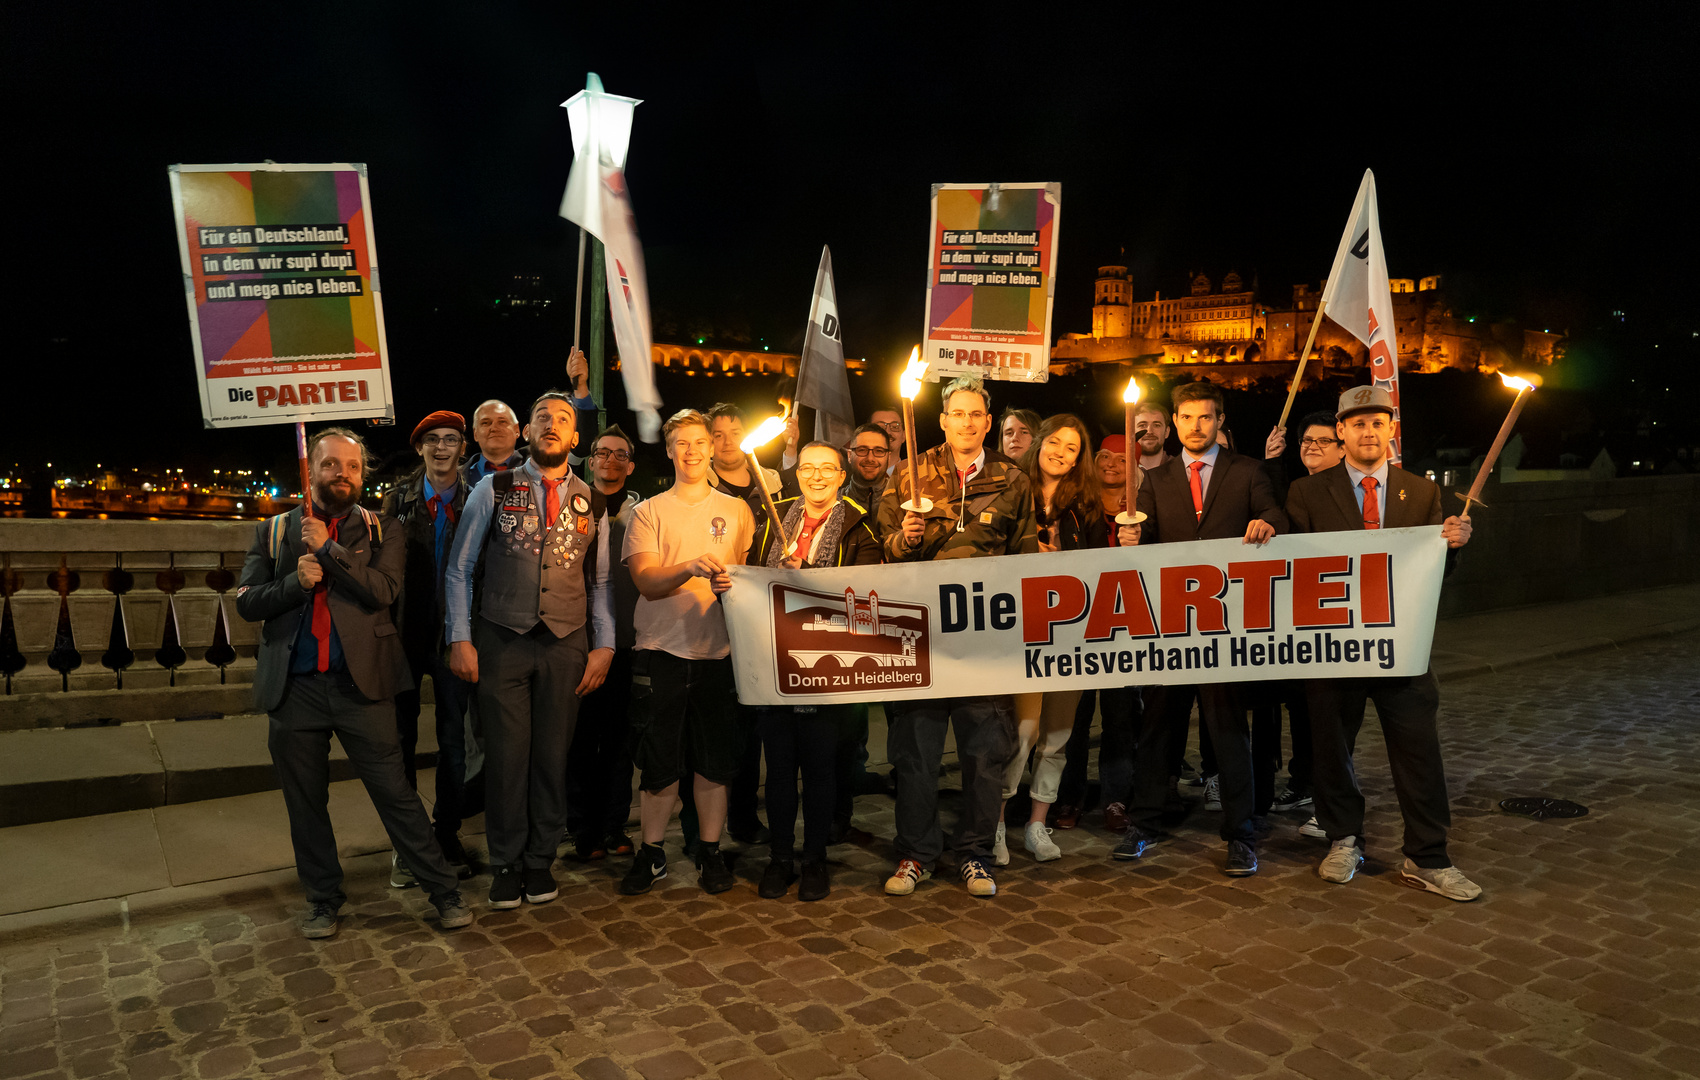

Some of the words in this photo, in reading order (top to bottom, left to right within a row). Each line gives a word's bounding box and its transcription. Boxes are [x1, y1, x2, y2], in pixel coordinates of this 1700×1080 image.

[200, 228, 225, 245] Für
[228, 228, 252, 244] ein
[254, 226, 349, 243] Deutschland,
[943, 231, 959, 244] Für
[959, 231, 974, 244] ein
[975, 231, 1038, 246] Deutschland,
[203, 256, 219, 272] in
[222, 255, 254, 271] dem
[257, 254, 283, 270] wir
[286, 252, 318, 271] supi
[320, 251, 353, 270] dupi
[941, 251, 951, 263] in
[952, 251, 972, 263] dem
[973, 251, 990, 263] wir
[991, 252, 1013, 266] supi
[1015, 252, 1038, 267] dupi
[940, 270, 957, 283] und
[958, 273, 984, 285] mega
[986, 271, 1007, 283] nice
[1009, 272, 1040, 285] leben.
[207, 282, 236, 298] und
[239, 283, 280, 299] mega
[282, 279, 314, 295] nice
[316, 278, 361, 294] leben.
[939, 347, 954, 359] Die
[955, 348, 1032, 370] PARTEI
[228, 387, 254, 403] Die
[256, 379, 370, 408] PARTEI
[504, 498, 528, 508] CSU
[938, 581, 1017, 634] Die
[1021, 552, 1395, 647] PARTEI
[1024, 637, 1219, 678] Kreisverband
[1230, 632, 1395, 669] Heidelberg
[788, 673, 828, 687] Dom
[832, 674, 850, 686] zu
[854, 671, 922, 685] Heidelberg
